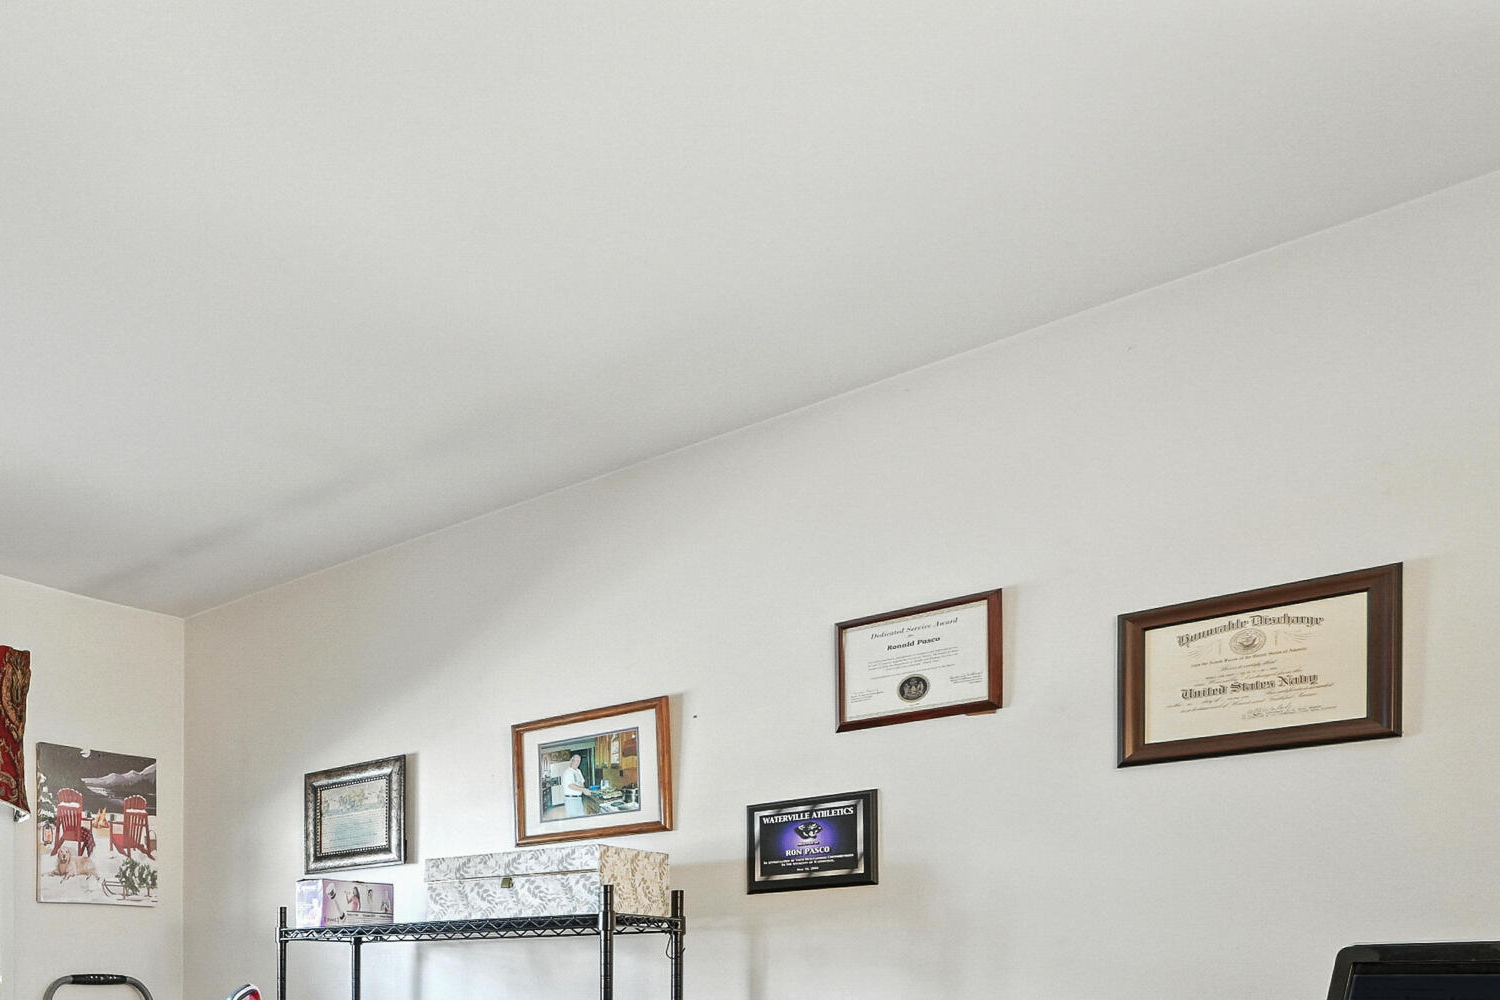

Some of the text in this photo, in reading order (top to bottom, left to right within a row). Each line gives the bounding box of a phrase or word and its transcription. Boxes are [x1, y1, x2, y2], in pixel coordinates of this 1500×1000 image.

[870, 617, 958, 640] Dedicated Service Award
[1176, 613, 1325, 647] Honorable Discharge
[887, 636, 941, 651] Ronald Pasco
[1181, 684, 1227, 700] United
[1230, 679, 1276, 694] States
[1279, 673, 1318, 688] Navy
[762, 806, 854, 824] WATERVILLE ATHLETICS
[785, 846, 831, 857] RON PASCO
